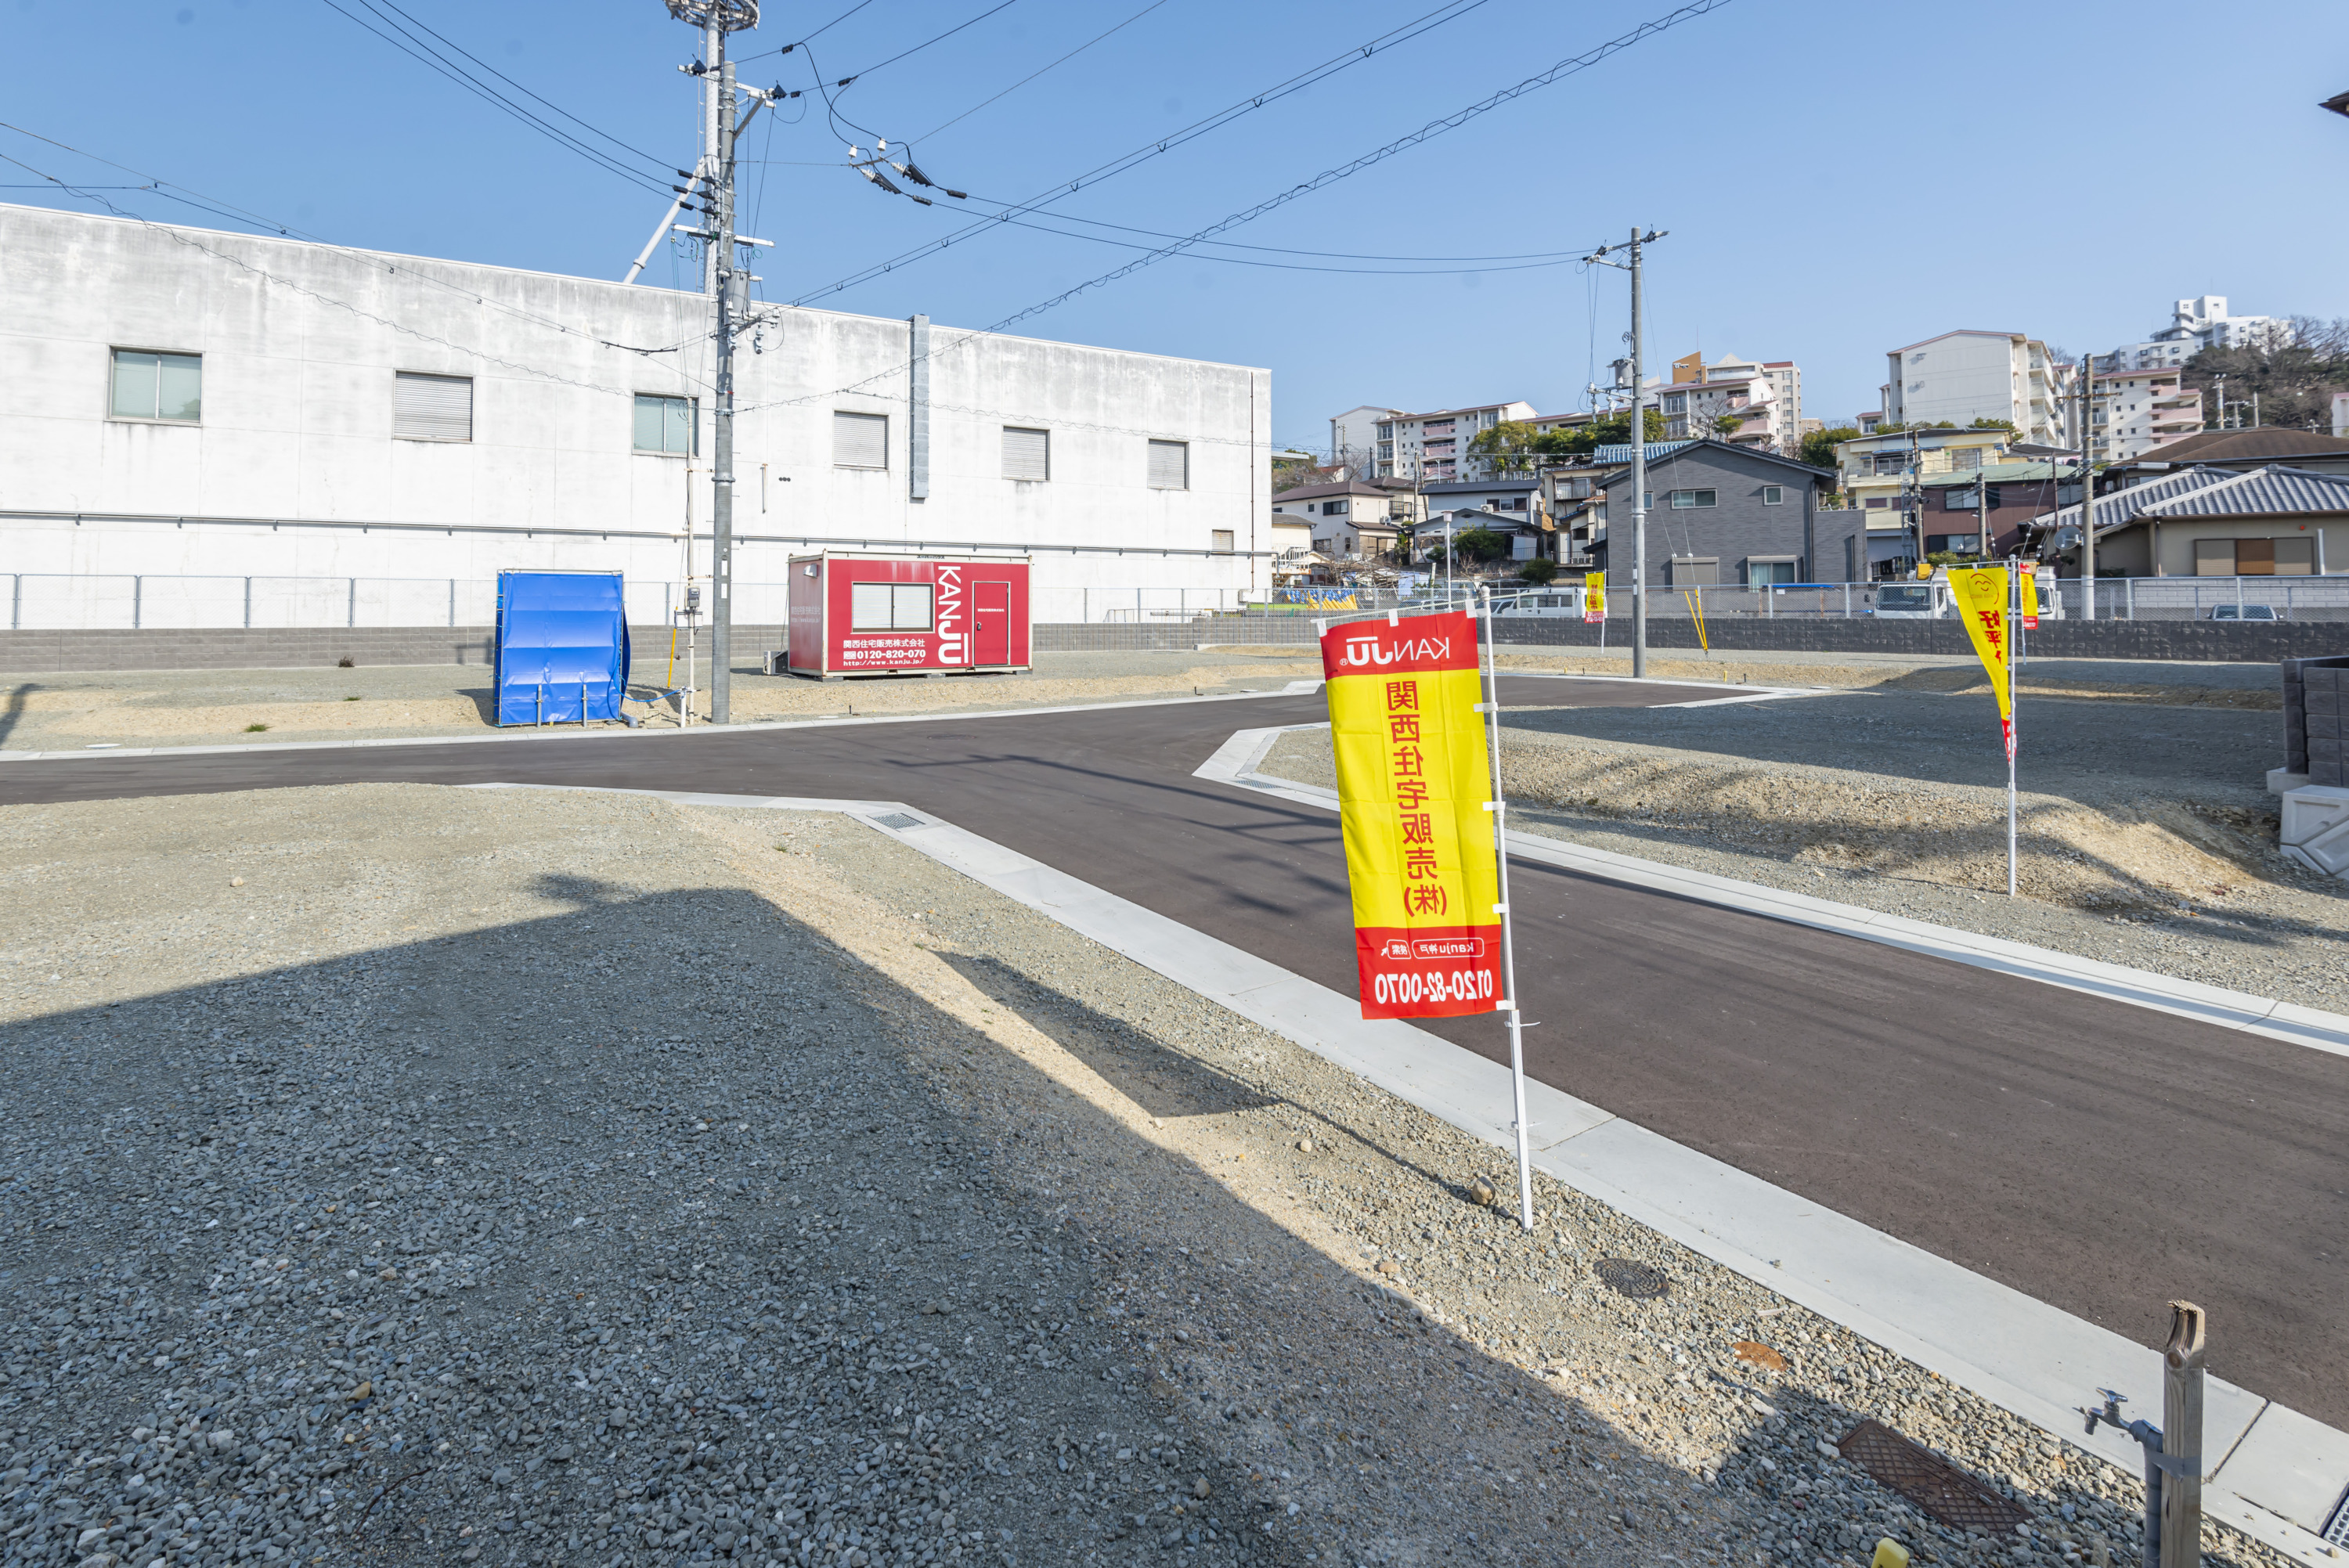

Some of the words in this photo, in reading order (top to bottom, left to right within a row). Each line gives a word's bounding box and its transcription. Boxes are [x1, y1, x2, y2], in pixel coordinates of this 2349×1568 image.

[843, 639, 926, 648] 関西住宅販売株式会社
[857, 650, 926, 659] 0120-820-070
